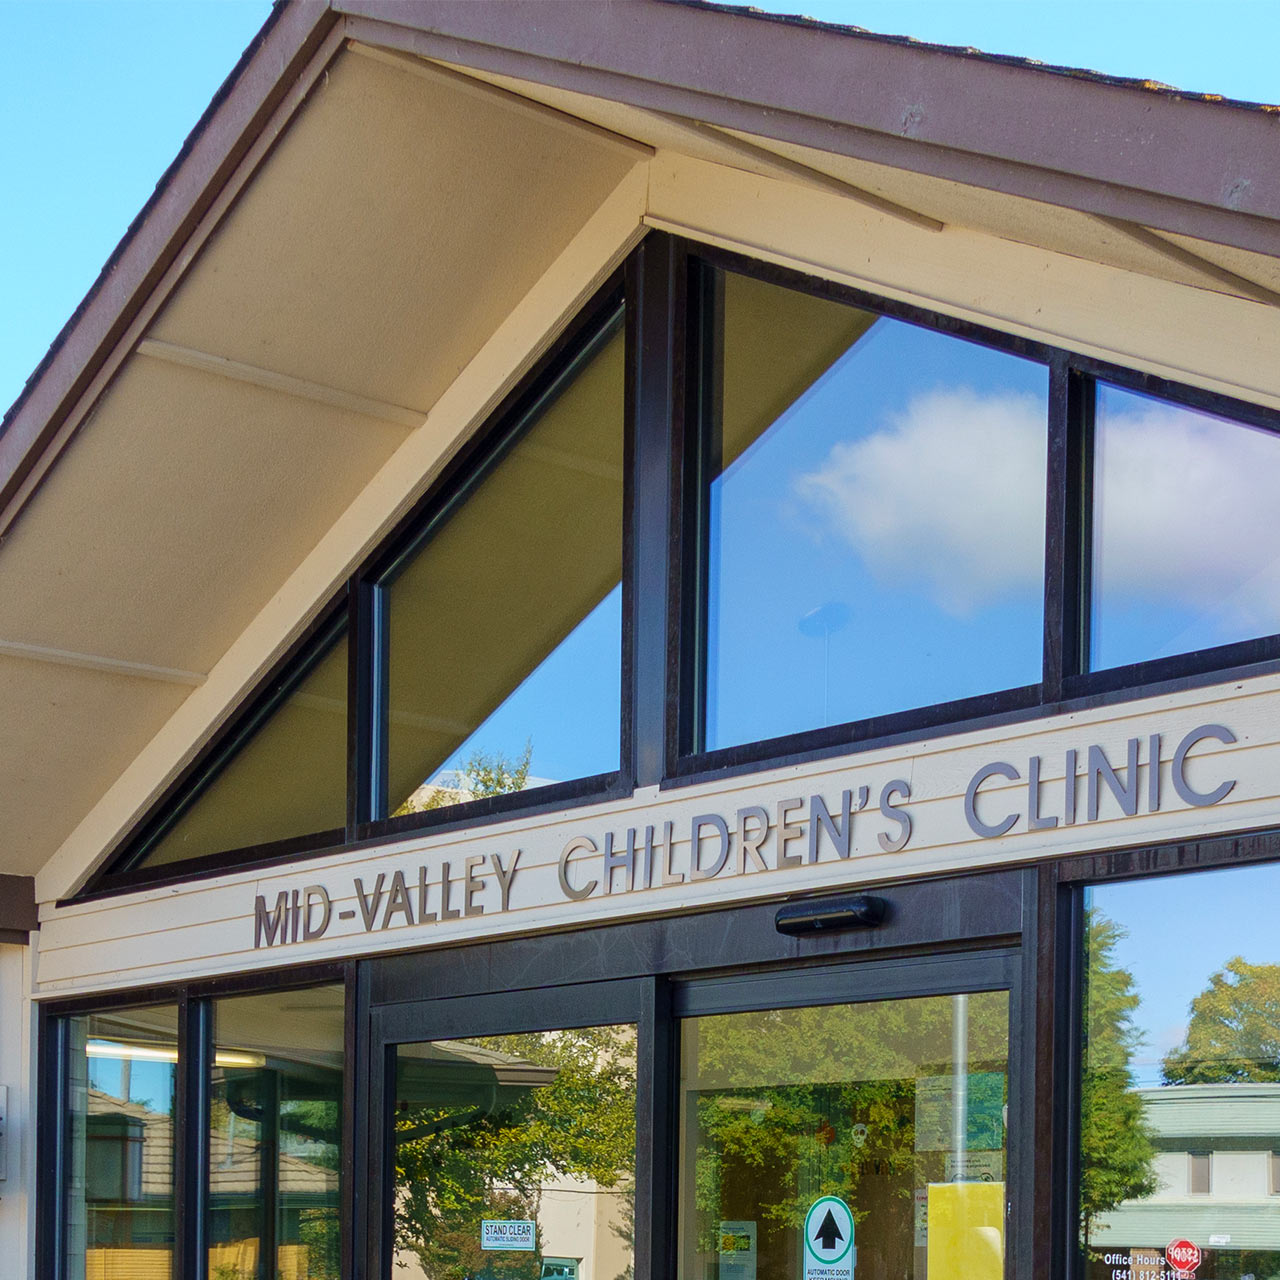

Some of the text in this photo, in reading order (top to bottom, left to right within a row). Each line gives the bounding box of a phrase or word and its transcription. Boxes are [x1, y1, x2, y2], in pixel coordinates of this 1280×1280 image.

[254, 724, 1237, 949] MID-VALLEY CHILDREN'S CLINIC
[485, 1225, 531, 1236] STAND CLEAR
[1104, 1254, 1166, 1265] Office Hours
